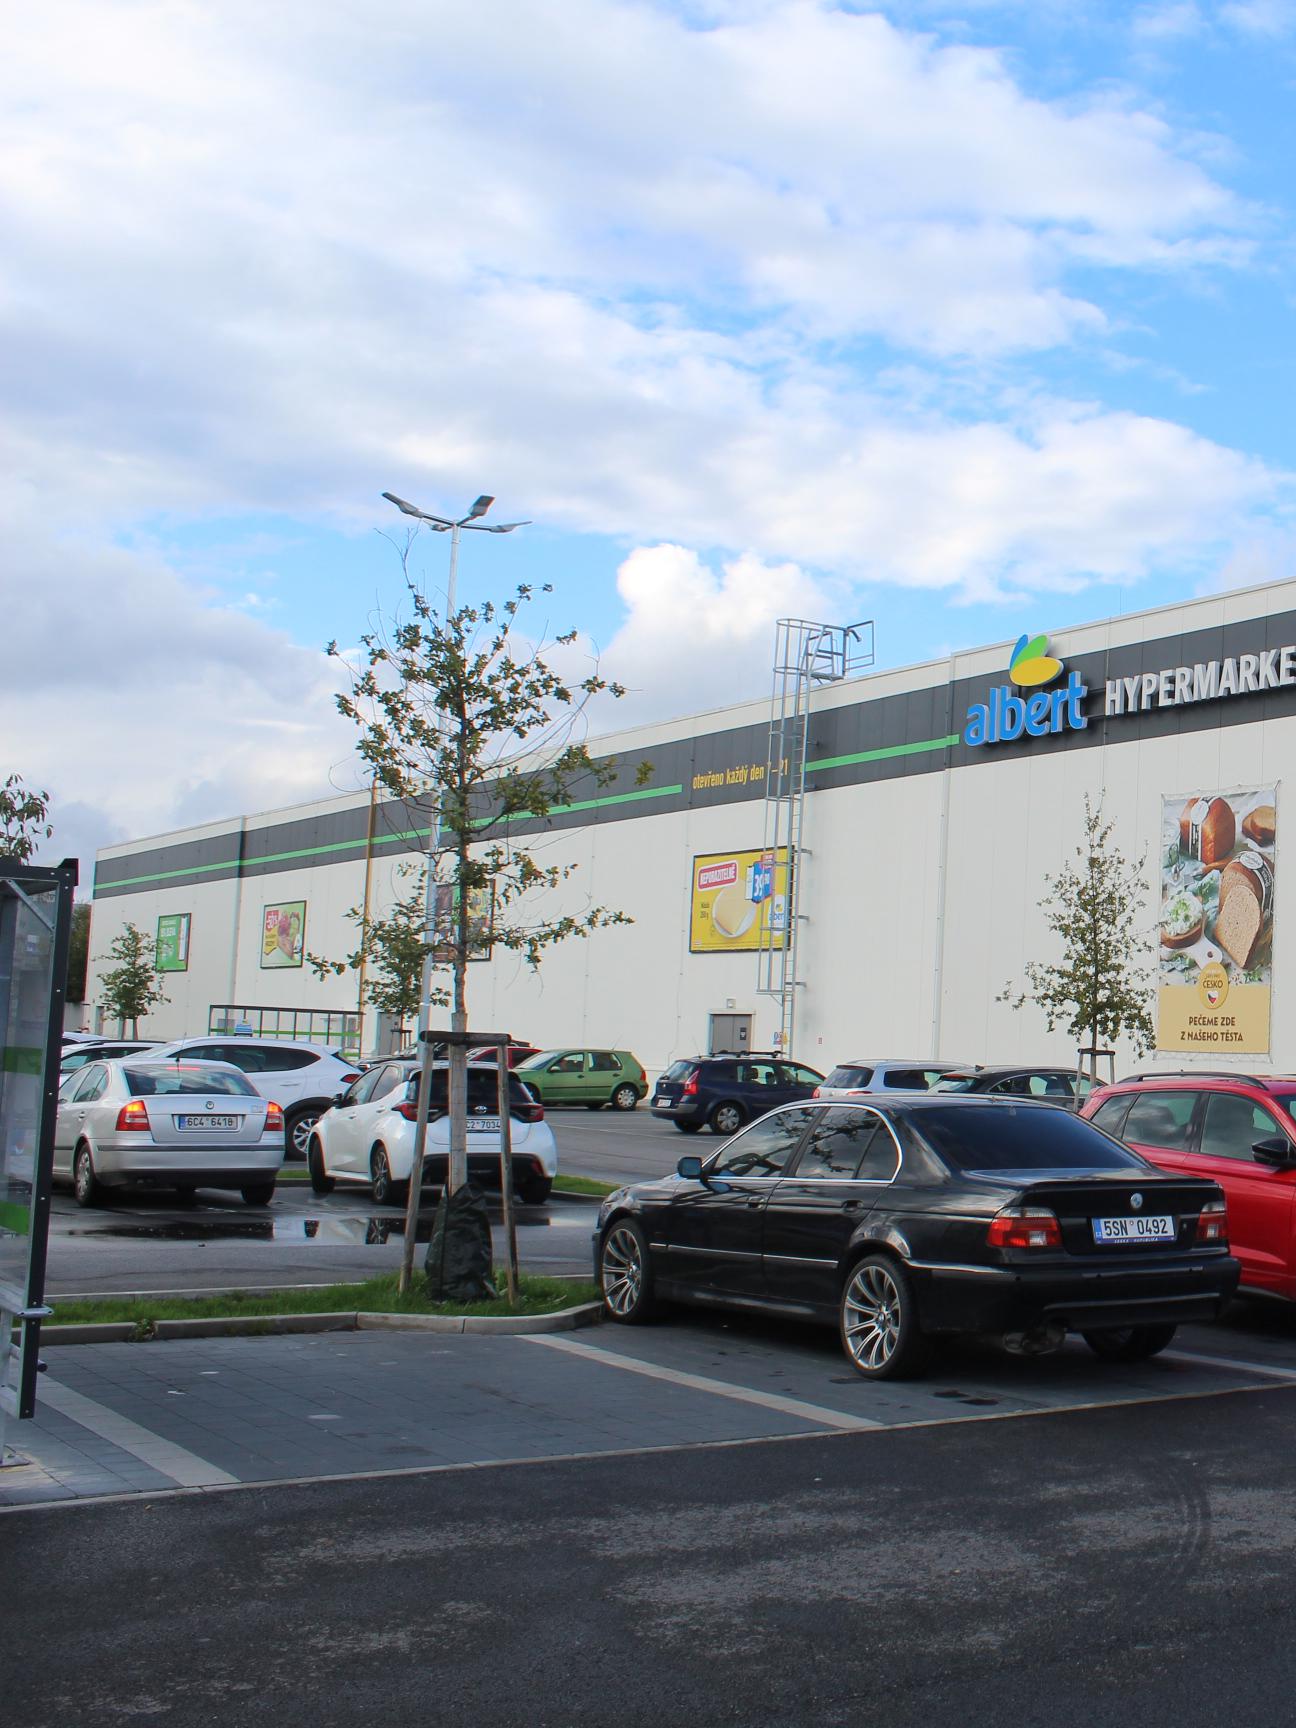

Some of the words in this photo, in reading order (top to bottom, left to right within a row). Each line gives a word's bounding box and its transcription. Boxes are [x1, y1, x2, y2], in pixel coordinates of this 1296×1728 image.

[965, 671, 1089, 747] albert
[693, 770, 724, 789] otevřeno
[726, 764, 748, 785] každý
[750, 764, 764, 781] den
[1189, 1014, 1218, 1026] PEČEME
[1221, 1017, 1236, 1026] ZDE
[1180, 1031, 1186, 1041] Z
[1188, 1029, 1218, 1041] NAŠEHO
[1220, 1029, 1243, 1041] TĚSTA
[187, 1117, 204, 1127] 6C4
[211, 1117, 233, 1127] 6418
[1104, 1219, 1128, 1236] 5SN
[1137, 1218, 1168, 1235] 0492
